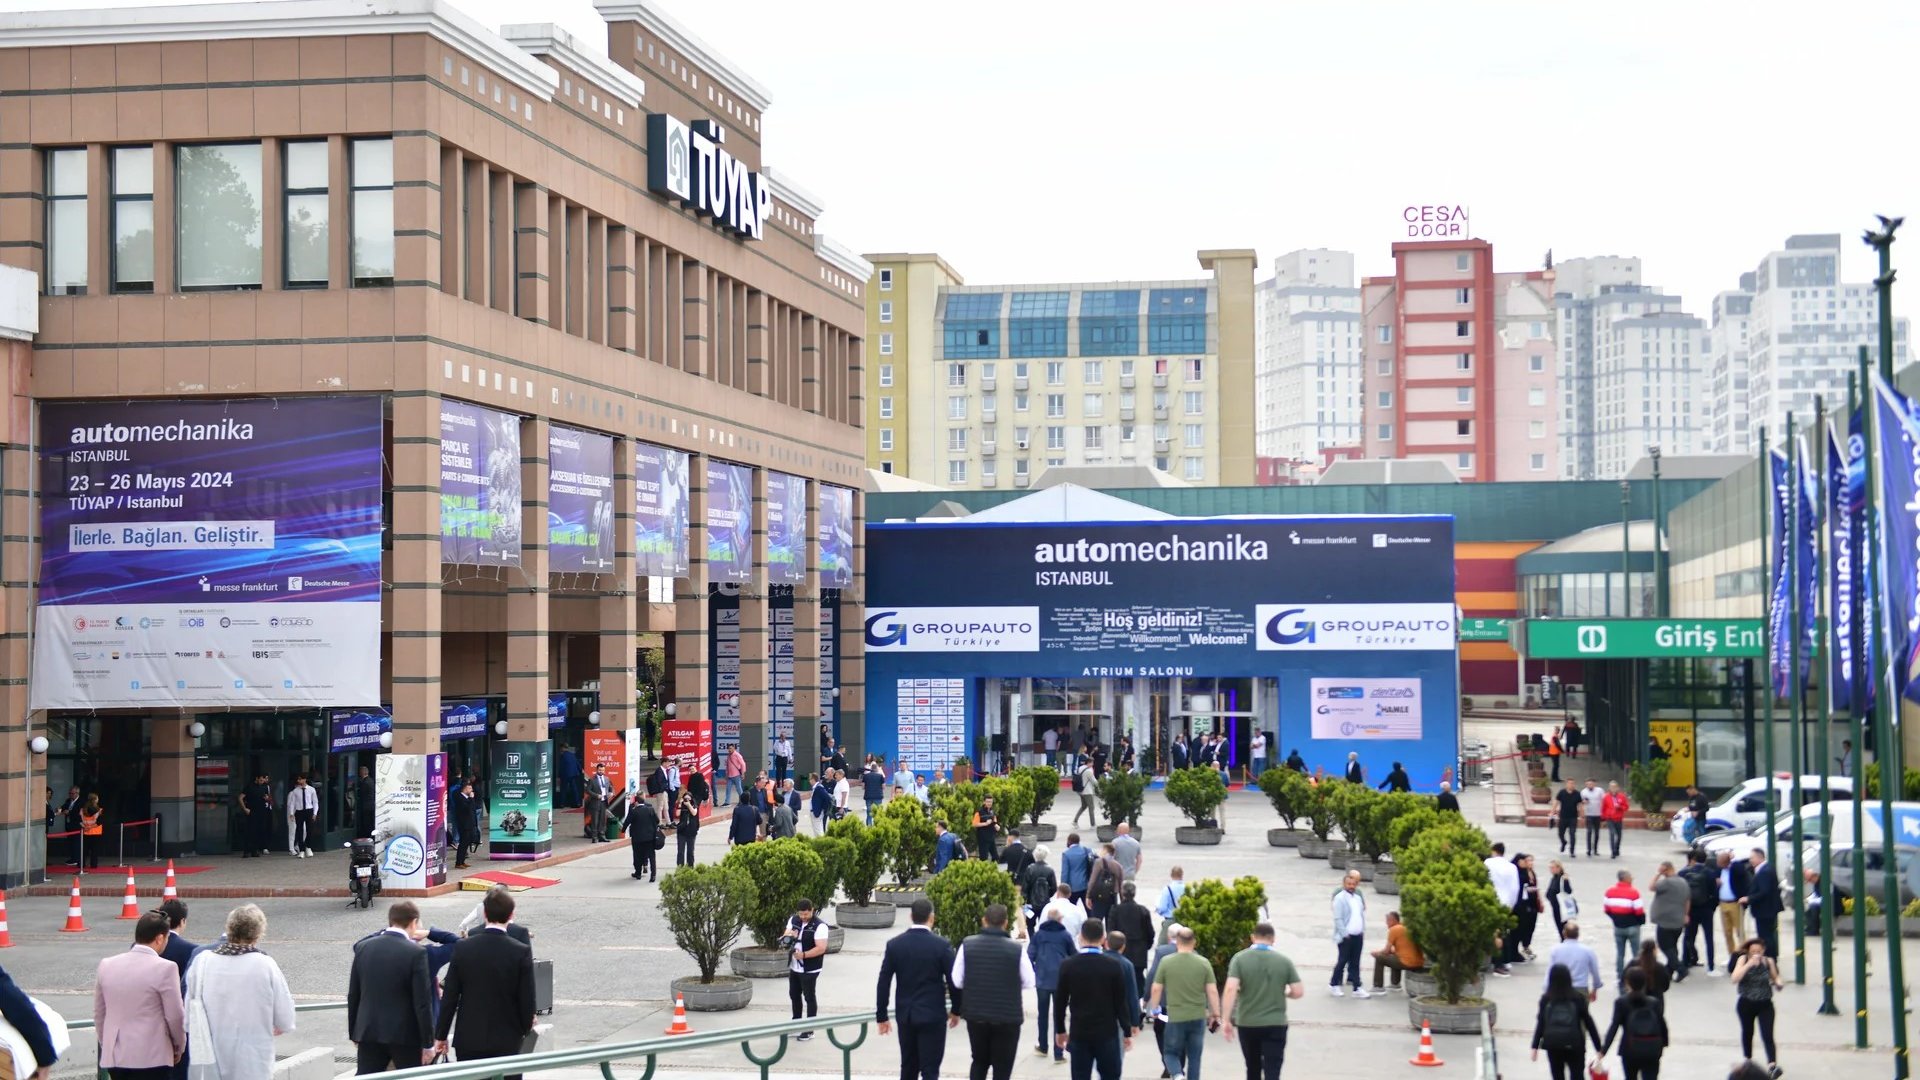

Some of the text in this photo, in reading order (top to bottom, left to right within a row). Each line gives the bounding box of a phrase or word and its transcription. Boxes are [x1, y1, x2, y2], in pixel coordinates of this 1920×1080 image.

[692, 119, 770, 240] TÜYAP
[71, 419, 253, 444] automechanika
[70, 449, 131, 463] ISTANBUL
[70, 475, 90, 492] 23
[110, 473, 131, 490] 26
[136, 473, 186, 491] Mayıs
[190, 472, 233, 488] 2024
[70, 496, 114, 511] TÜYAP
[127, 494, 183, 509] Istanbul
[74, 526, 264, 547] İlerle. Bağlan. Geliştir.
[1035, 533, 1268, 563] automechanika
[1036, 571, 1113, 586] ISTANBUL
[214, 581, 278, 592] messe frankfurt
[912, 622, 1032, 634] GROUPAUTO
[1104, 612, 1134, 631] Hoş
[1138, 611, 1202, 630] geldiniz!
[1322, 620, 1449, 632] GROUPAUTO
[944, 638, 1000, 646] Türkiye
[1130, 633, 1181, 643] Willkommen!
[1189, 633, 1247, 645] Welcome!
[1356, 636, 1415, 644] Türkiye
[1655, 624, 1717, 652] Giriş
[1083, 666, 1193, 676] ATRIUM SALONU
[344, 725, 358, 734] KAYIT
[359, 724, 365, 733] VE
